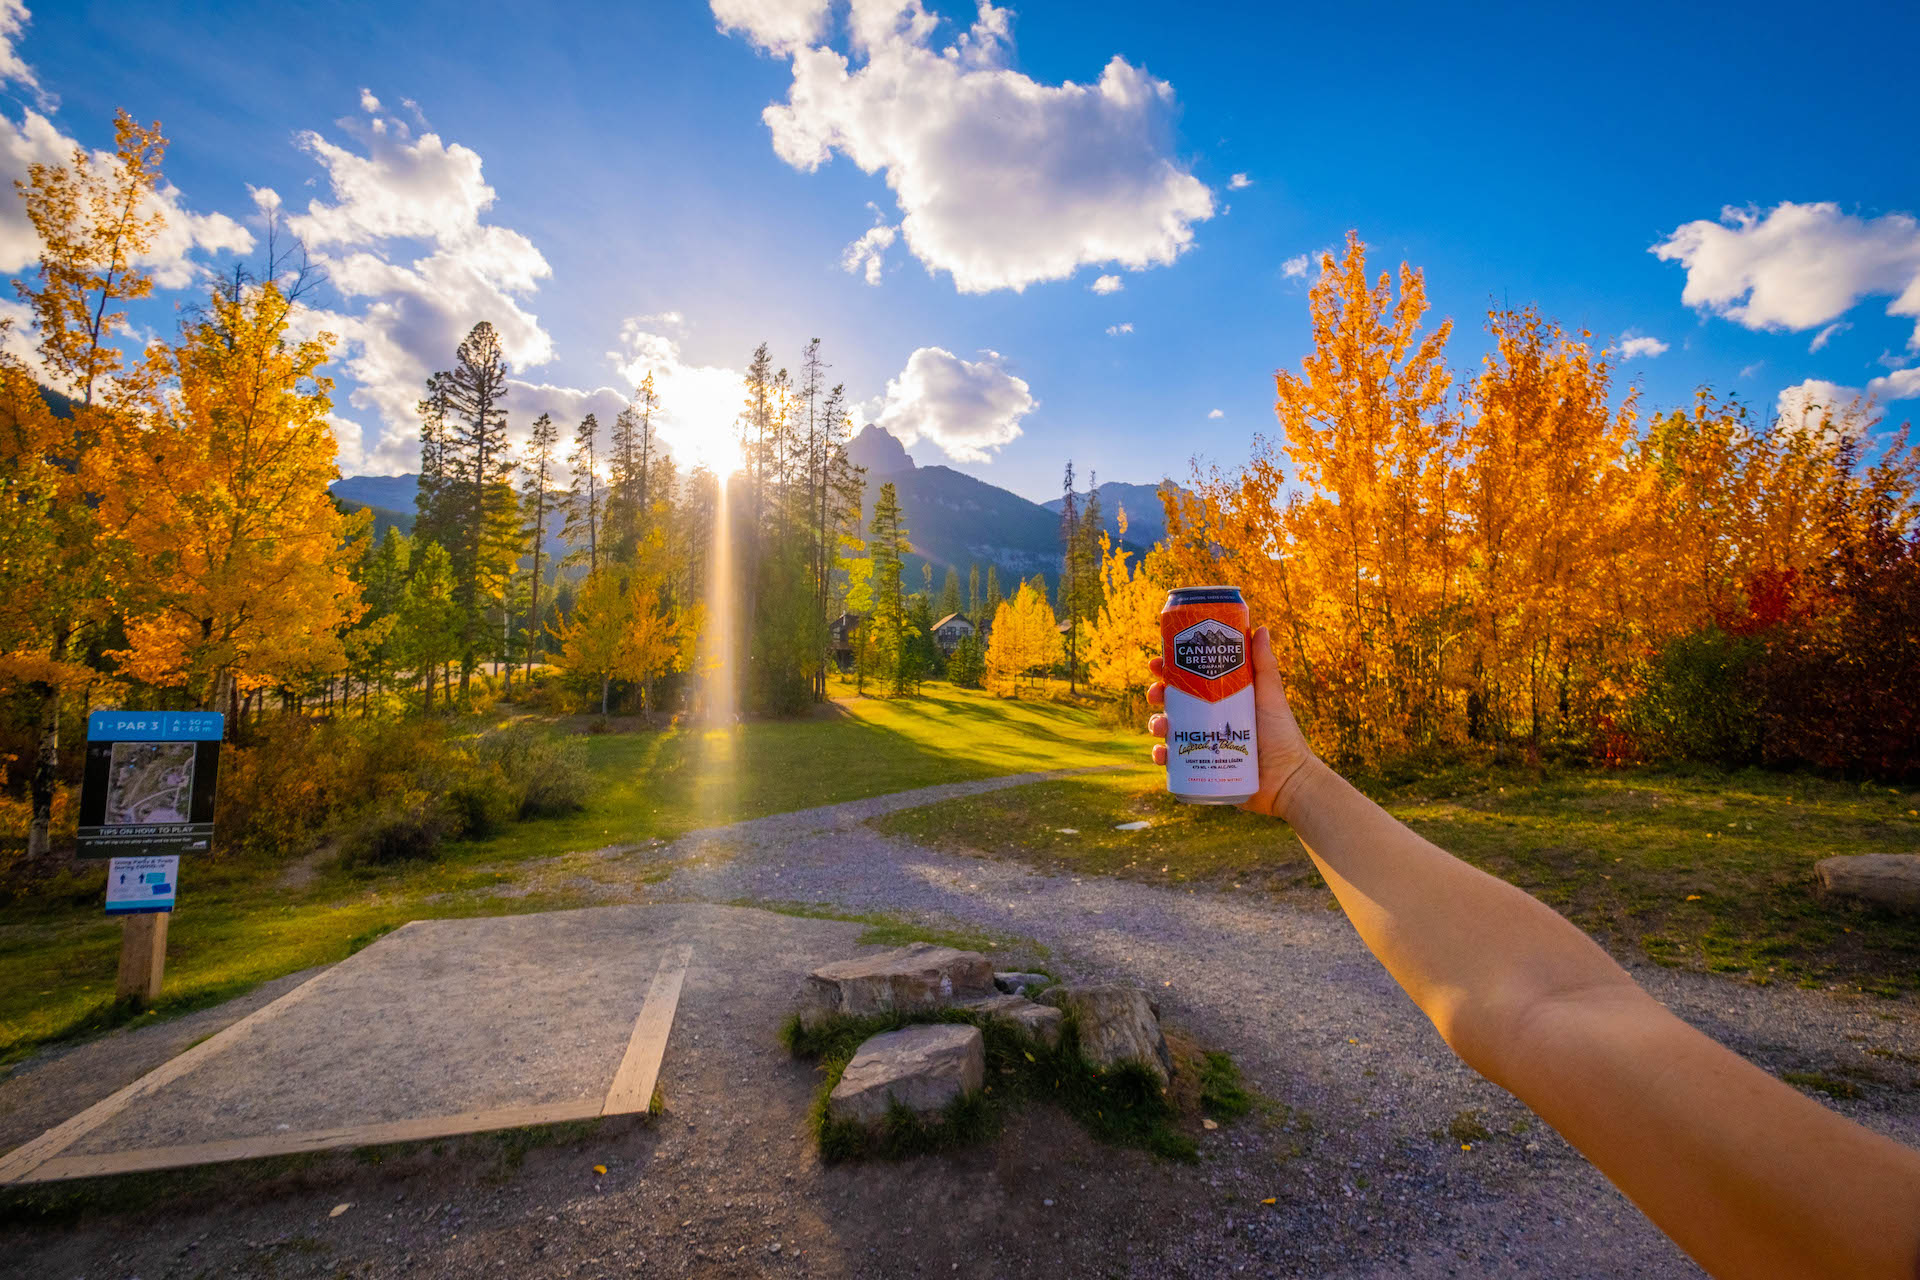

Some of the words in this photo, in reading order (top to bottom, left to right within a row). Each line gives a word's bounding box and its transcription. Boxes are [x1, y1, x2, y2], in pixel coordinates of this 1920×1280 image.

[1178, 645, 1242, 655] CANMORE
[1185, 655, 1237, 664] BREWING
[97, 721, 103, 730] 1
[117, 721, 147, 731] PAR
[151, 721, 159, 731] 3
[1174, 725, 1251, 742] HIGHLINE
[99, 828, 118, 836] TIPS
